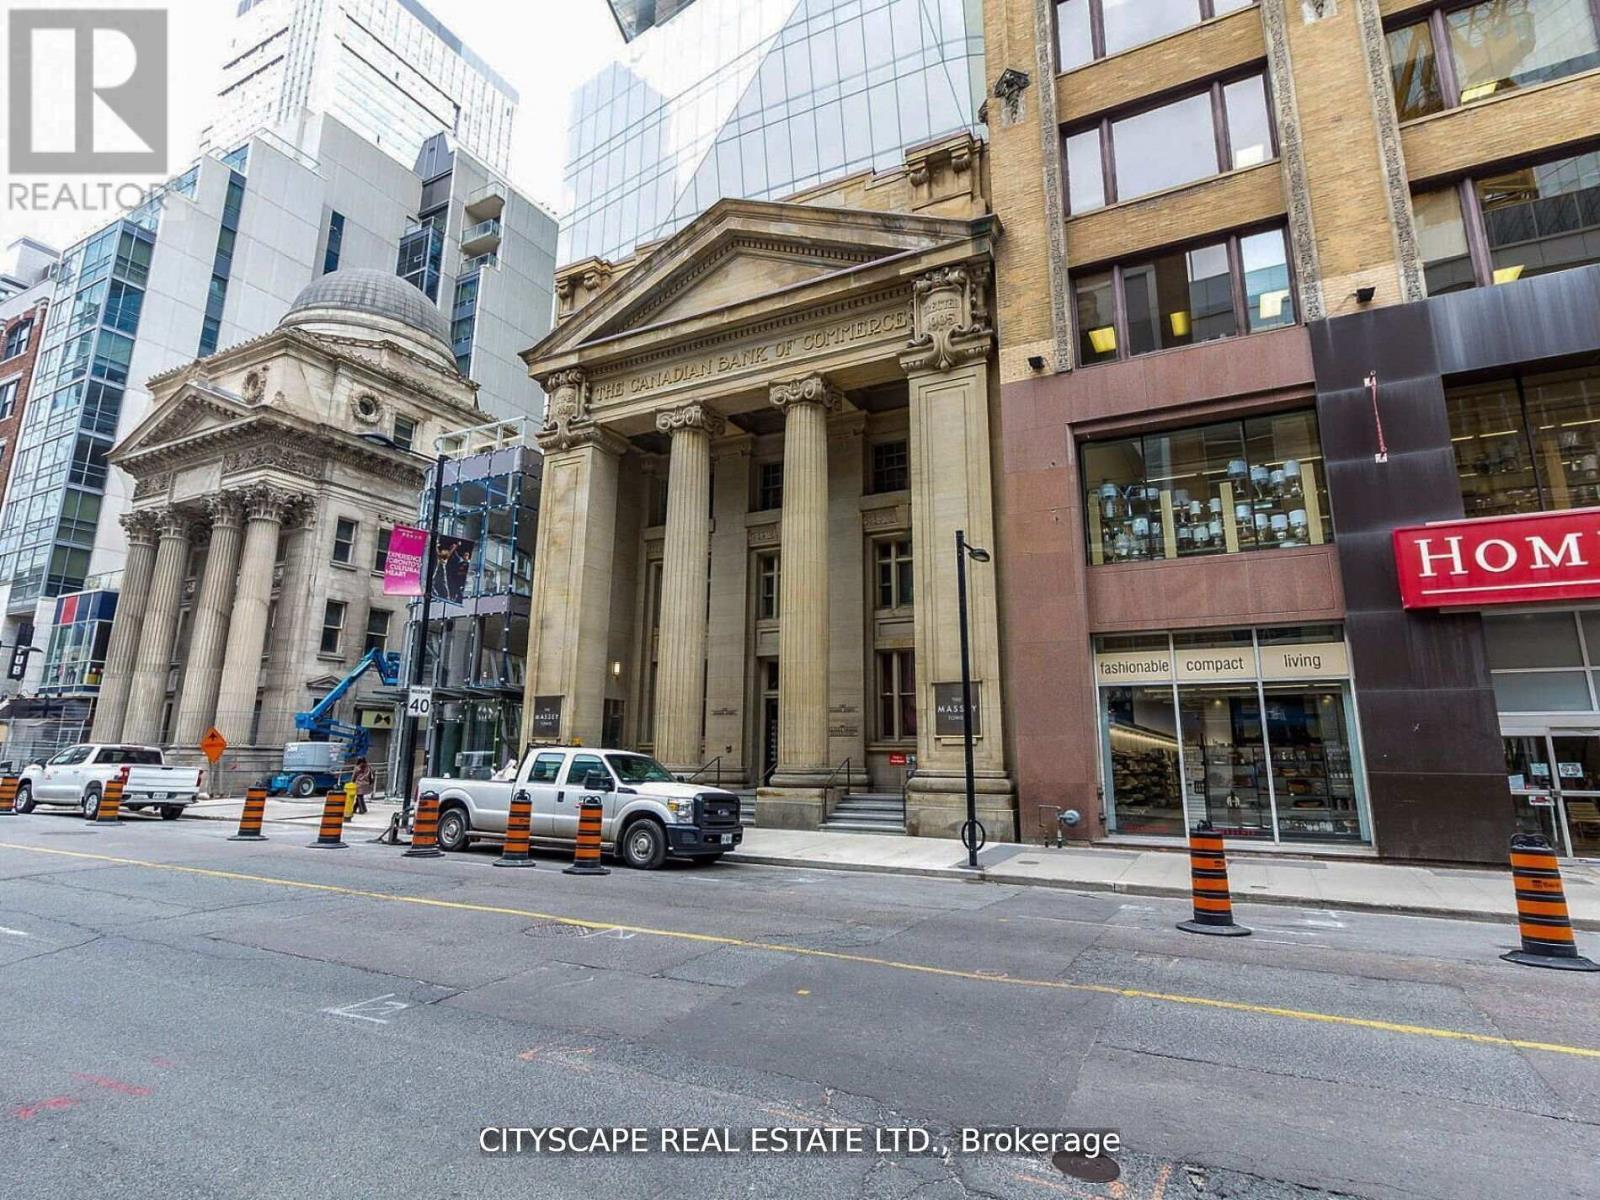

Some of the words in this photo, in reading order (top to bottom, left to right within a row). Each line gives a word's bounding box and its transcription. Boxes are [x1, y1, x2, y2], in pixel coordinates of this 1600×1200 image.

[596, 380, 624, 401] THE
[630, 359, 712, 393] CANADIAN
[717, 345, 768, 373] BANK
[775, 338, 795, 358] OF
[802, 311, 908, 351] COMMERCE
[1414, 530, 1600, 578] HOM
[1100, 659, 1169, 675] fashionable
[1186, 656, 1244, 673] compact
[1283, 653, 1321, 670] living
[410, 698, 430, 713] 40
[937, 704, 977, 713] MASSY
